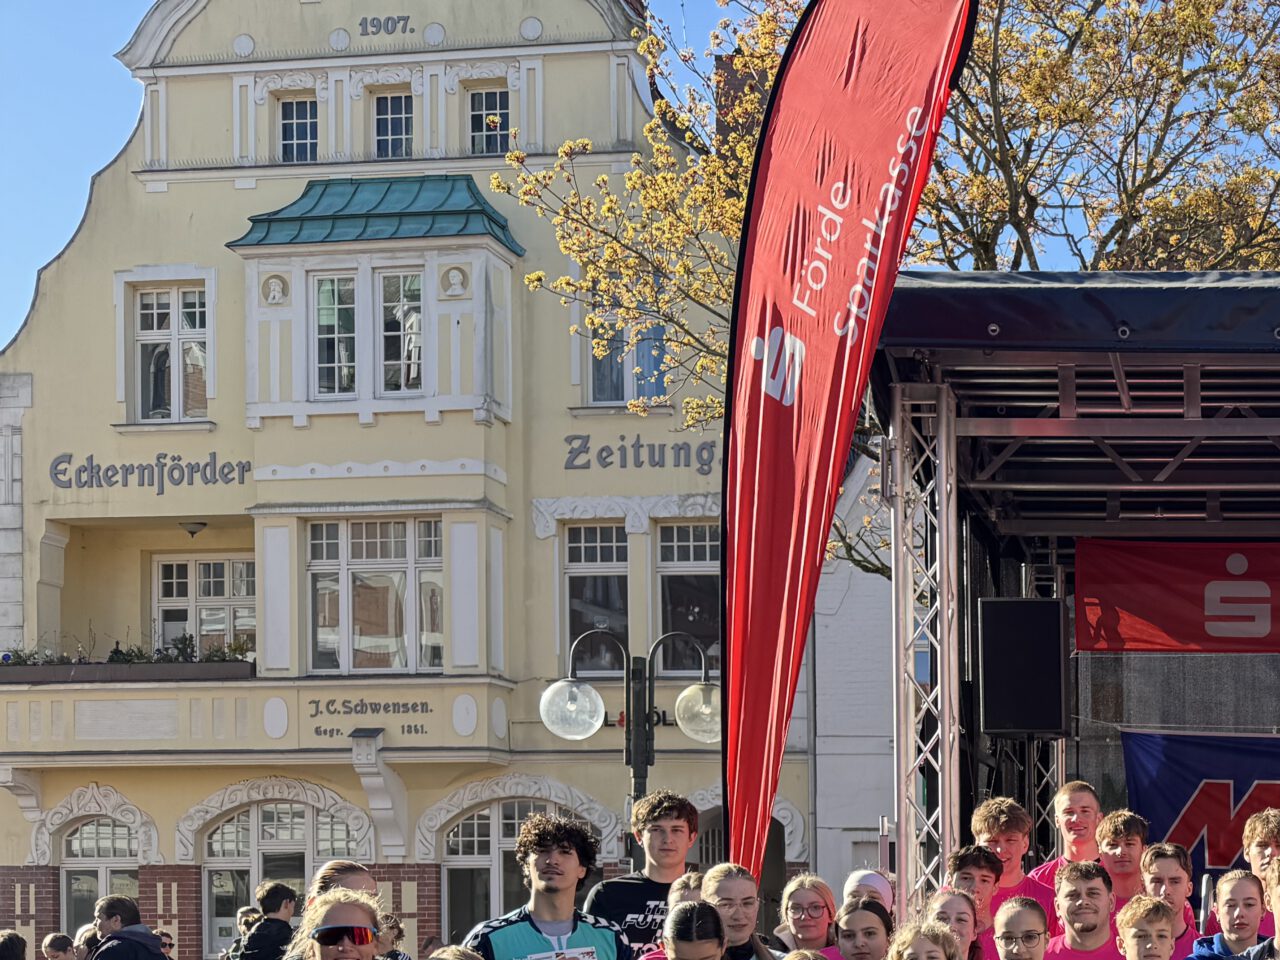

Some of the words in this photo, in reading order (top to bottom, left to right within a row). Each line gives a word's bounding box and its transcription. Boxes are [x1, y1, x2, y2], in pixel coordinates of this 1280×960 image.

[359, 16, 415, 36] 1907.
[834, 106, 929, 346] Sparkasse
[792, 181, 852, 317] Förde
[50, 452, 252, 496] Eckernförder
[401, 724, 428, 735] 1861.
[645, 901, 669, 915] TH
[621, 914, 666, 929] FUT
